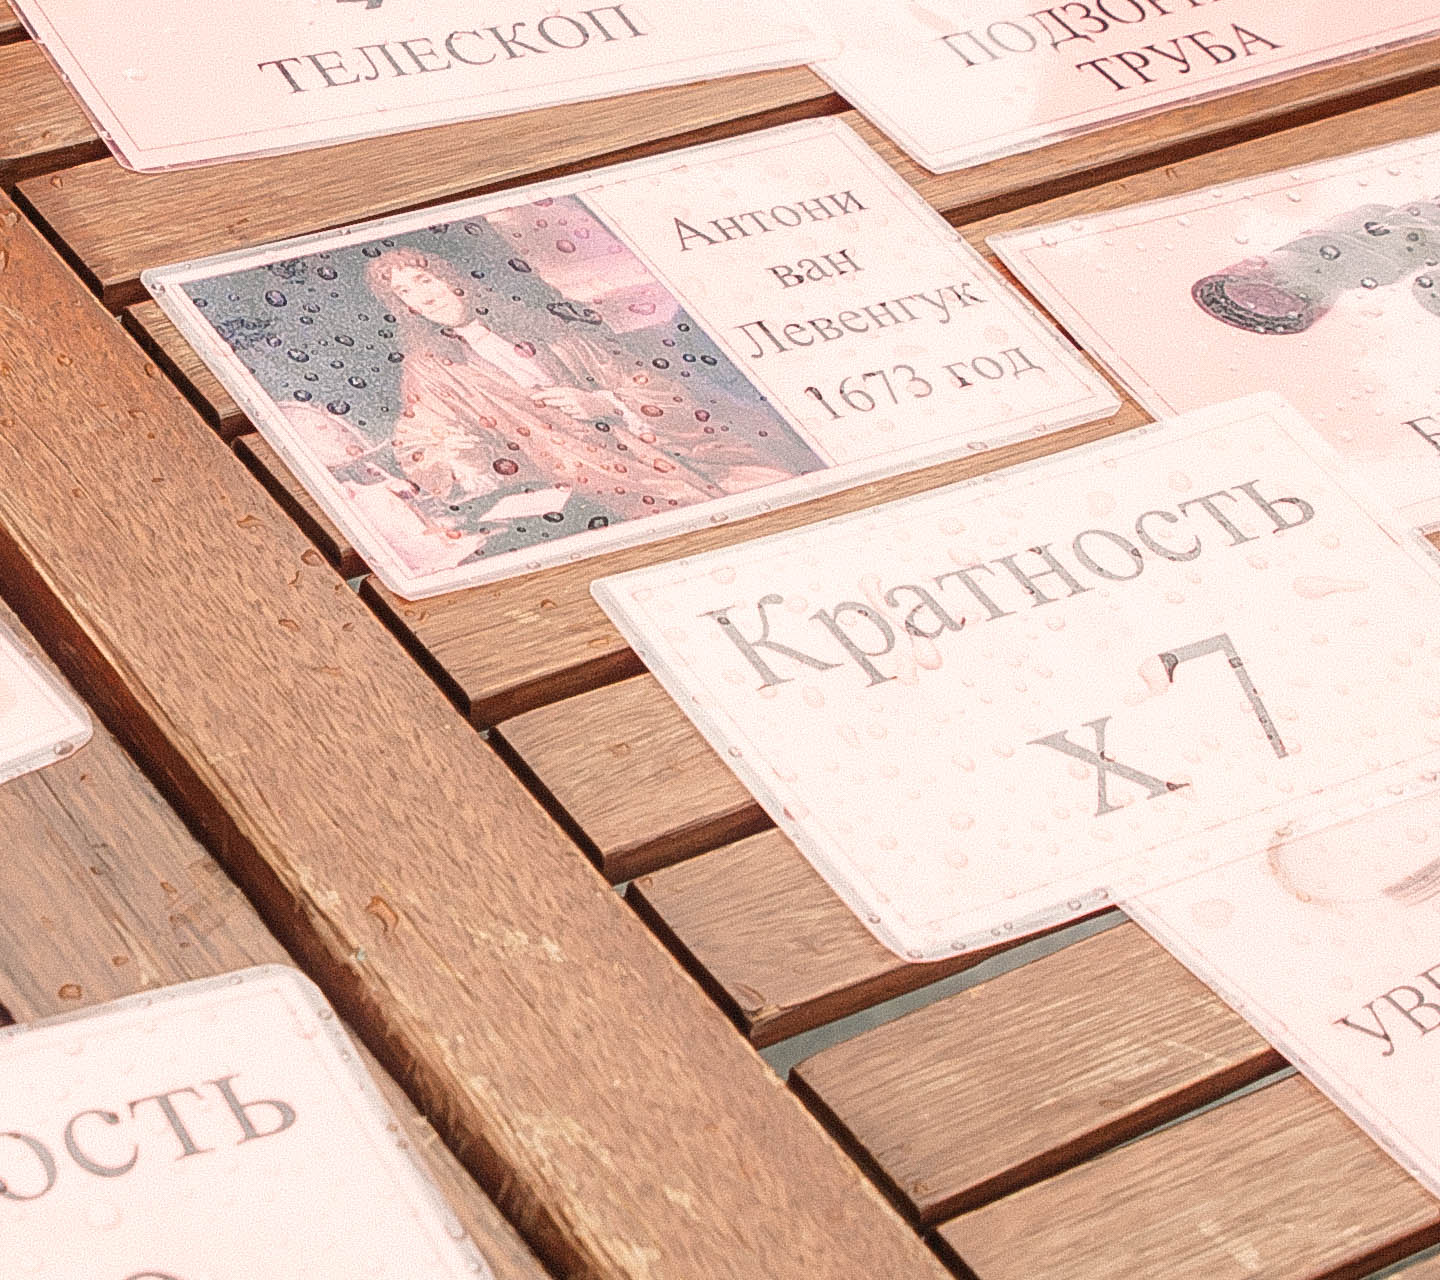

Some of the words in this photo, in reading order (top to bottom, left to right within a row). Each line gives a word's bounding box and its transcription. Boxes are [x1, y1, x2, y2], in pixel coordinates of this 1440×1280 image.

[257, 3, 648, 95] ТЕЛЕСКОП
[1075, 23, 1283, 91] ТРУБА
[674, 190, 869, 252] Антони
[767, 249, 865, 290] ван
[735, 282, 988, 359] Левенгук
[804, 364, 934, 421] 1673
[943, 346, 1045, 388] год
[698, 479, 1317, 690] Кратность
[1157, 632, 1290, 760] 7
